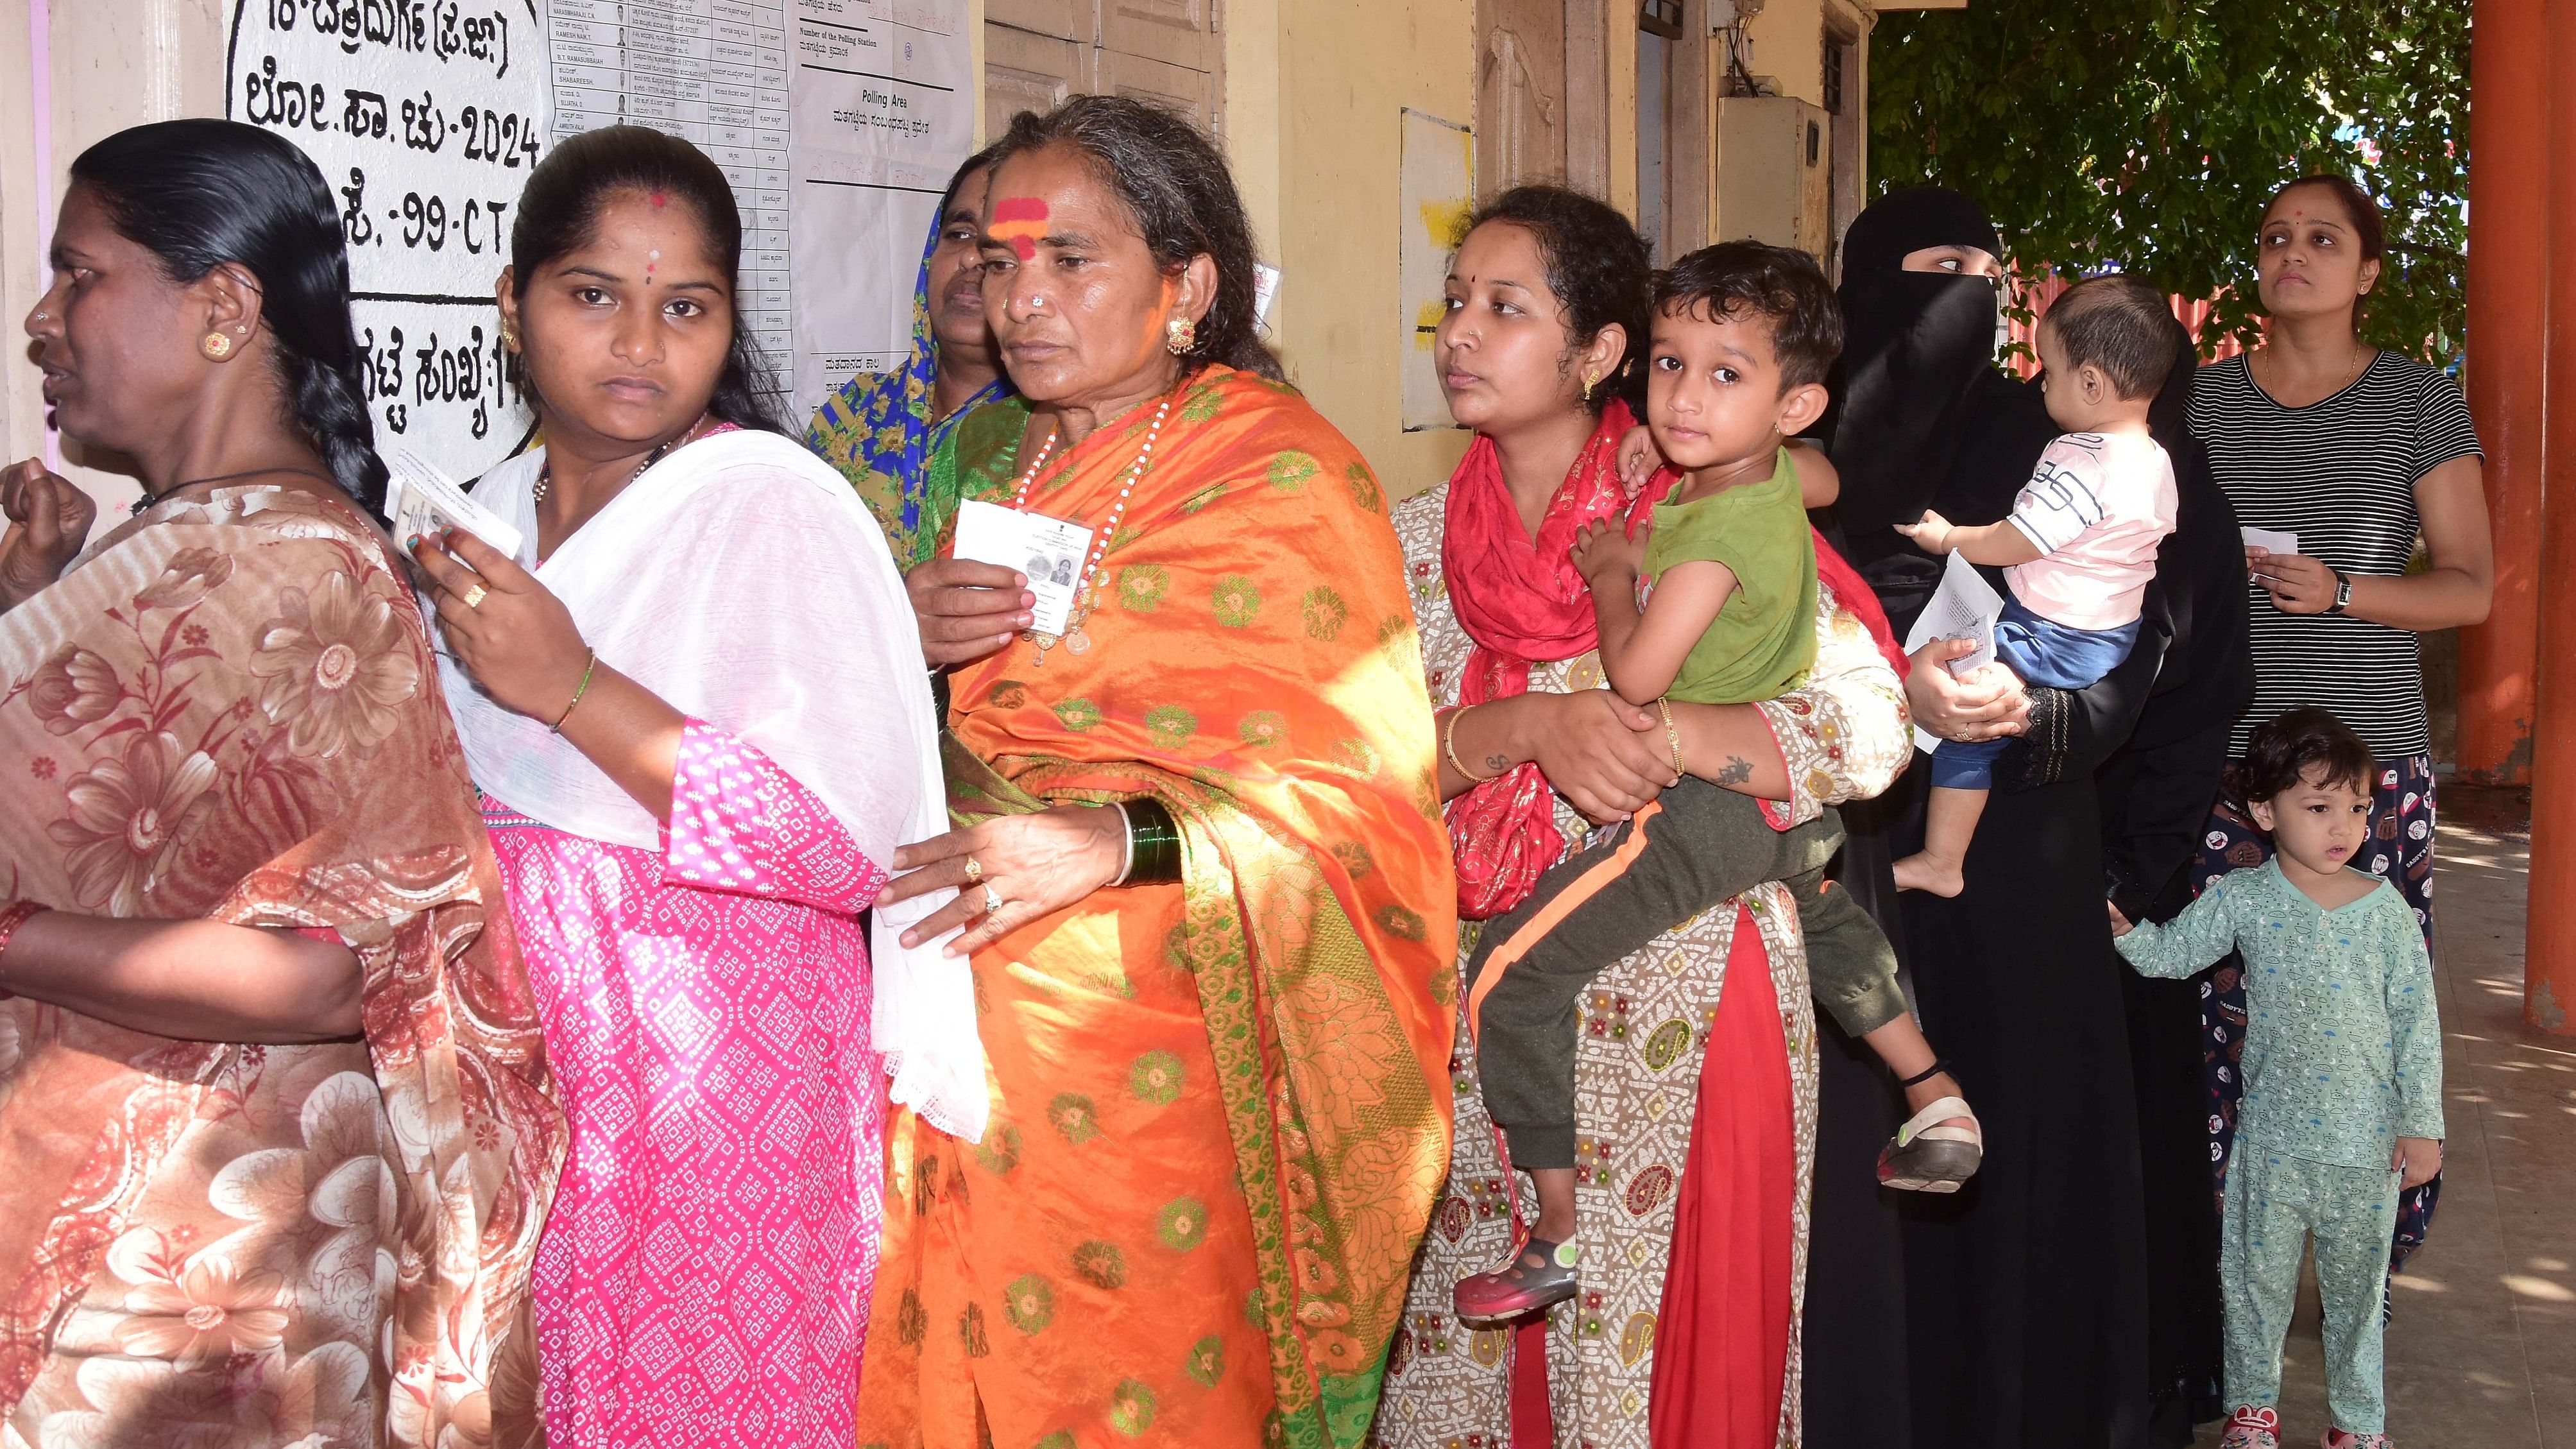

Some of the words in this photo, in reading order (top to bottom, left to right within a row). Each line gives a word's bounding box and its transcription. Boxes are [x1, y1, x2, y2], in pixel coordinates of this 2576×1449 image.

[799, 28, 820, 39] Number
[838, 34, 856, 46] Polling
[858, 37, 877, 47] Station
[862, 89, 888, 108] Polling
[891, 94, 907, 108] Area
[825, 357, 862, 370] ಮತದಾನದ
[866, 357, 880, 369] ಕಾಲ
[355, 327, 407, 434] ಗಟ್ಟೆ
